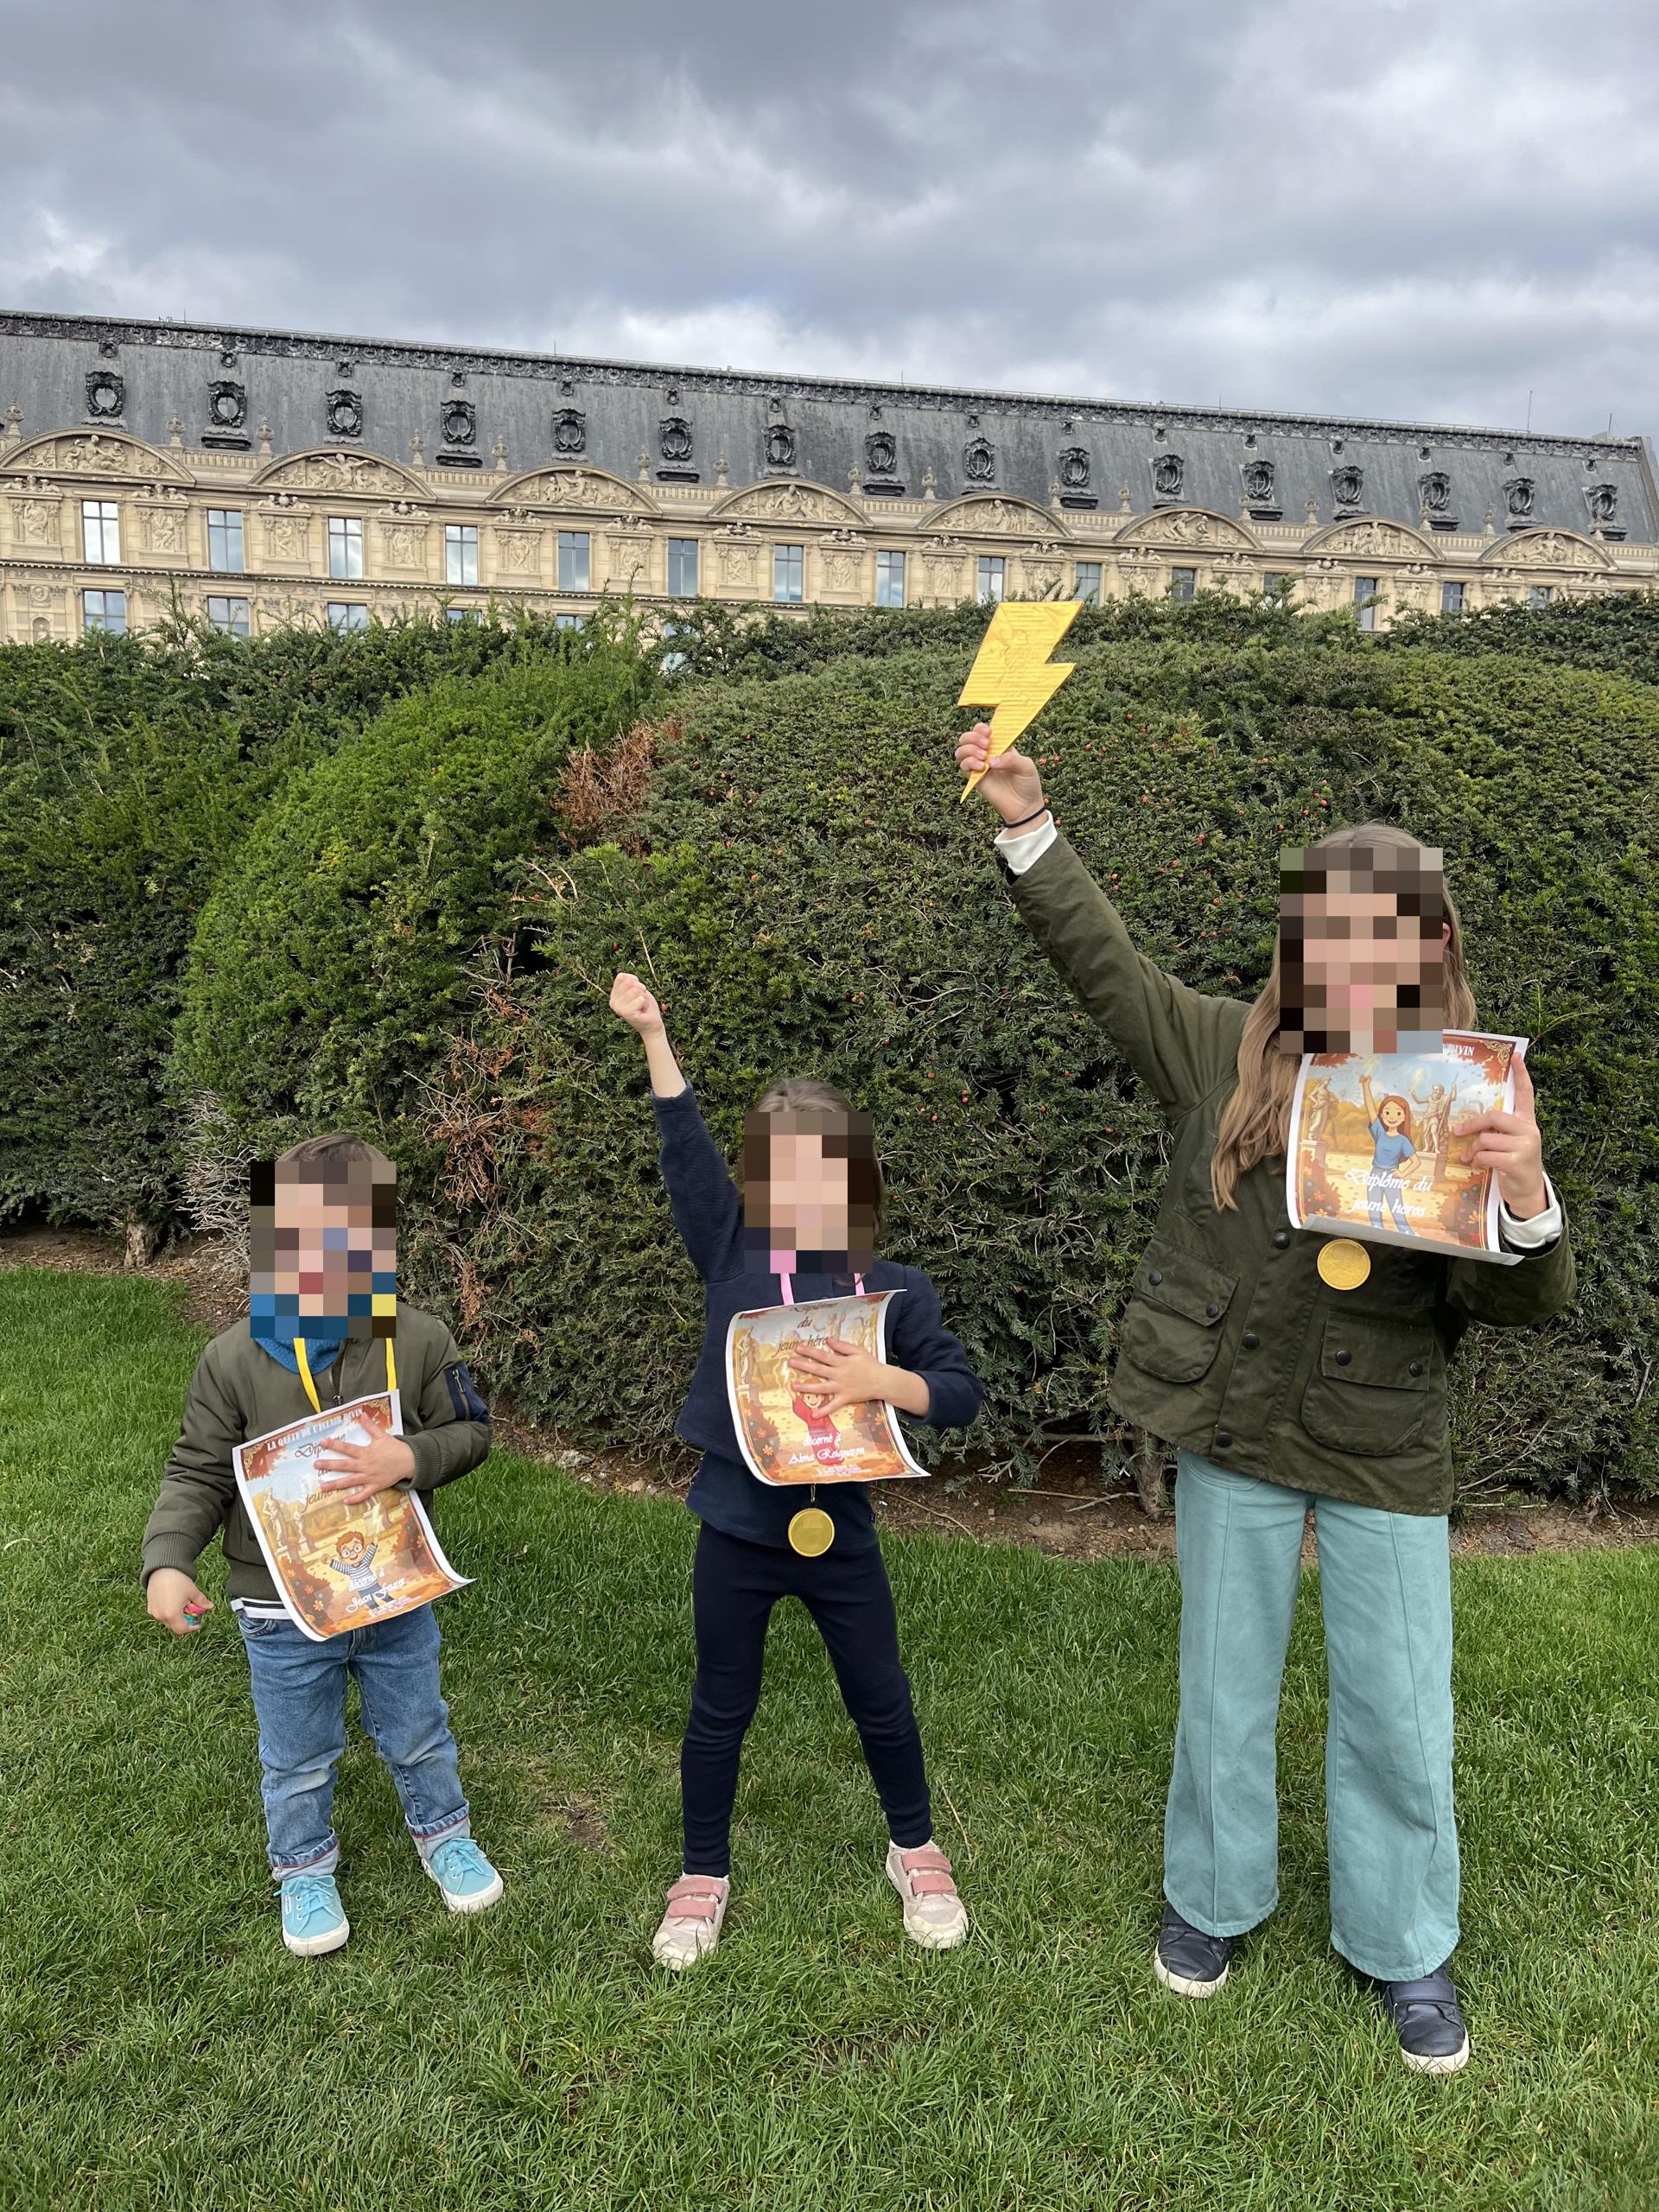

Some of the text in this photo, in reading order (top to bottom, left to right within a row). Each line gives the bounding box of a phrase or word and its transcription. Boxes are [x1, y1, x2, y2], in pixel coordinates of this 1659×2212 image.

[1344, 1168, 1433, 1192] Diplôme du
[1345, 1198, 1427, 1217] jeune héros
[797, 1317, 813, 1328] du
[266, 1441, 276, 1452] LA
[788, 1452, 816, 1464] Alma
[346, 1593, 372, 1612] Jean
